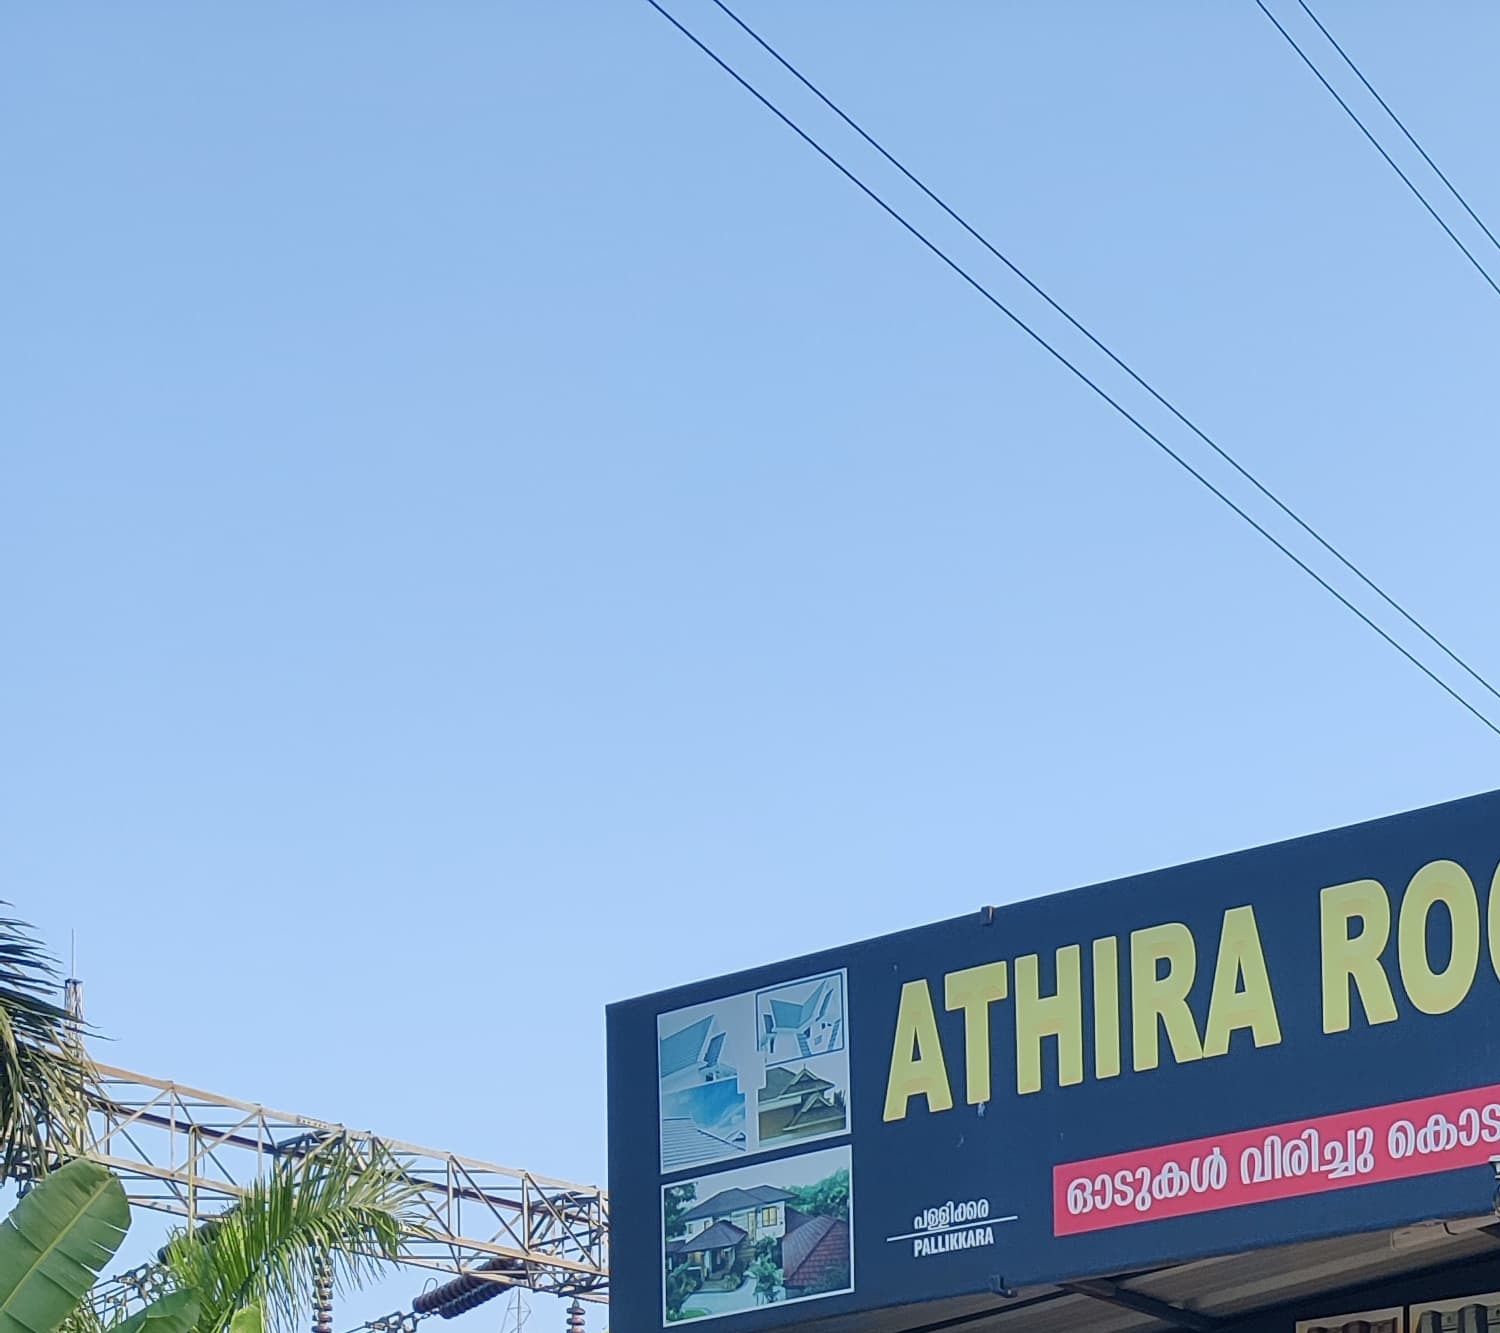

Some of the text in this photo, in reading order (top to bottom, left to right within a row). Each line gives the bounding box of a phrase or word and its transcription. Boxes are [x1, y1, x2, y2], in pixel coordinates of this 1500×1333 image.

[883, 905, 1282, 1122] ATHIRA
[1066, 1147, 1227, 1216] ഓടുകൾ
[1240, 1126, 1376, 1185] വിരിച്ചു
[913, 1198, 989, 1231] പള്ളിക്കര
[913, 1226, 994, 1258] PALLIKKARA
